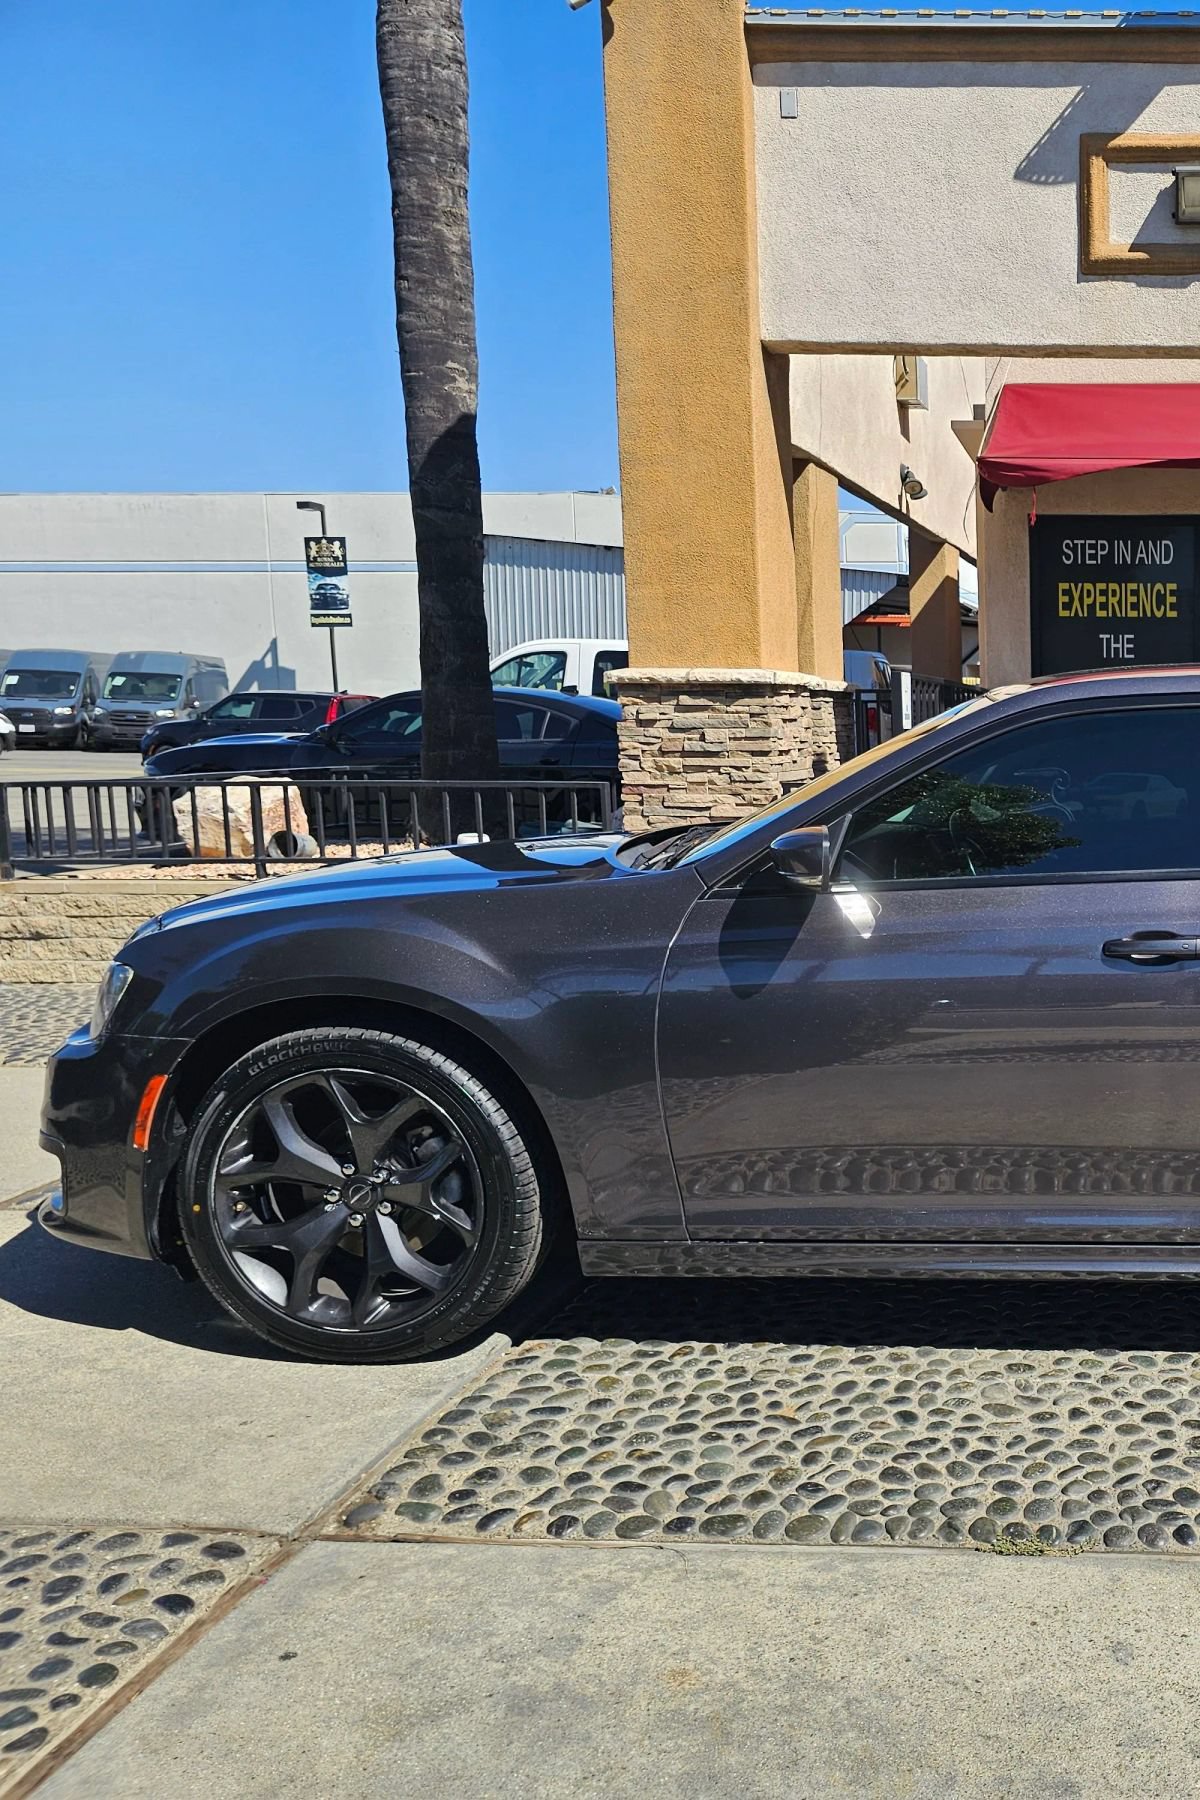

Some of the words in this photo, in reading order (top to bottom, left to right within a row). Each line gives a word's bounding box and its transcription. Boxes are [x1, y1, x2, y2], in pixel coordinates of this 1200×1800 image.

[1062, 539, 1109, 565] STEP
[1114, 539, 1131, 565] IN
[1135, 539, 1174, 565] AND
[1058, 582, 1178, 618] EXPERIENCE
[1099, 634, 1135, 658] THE
